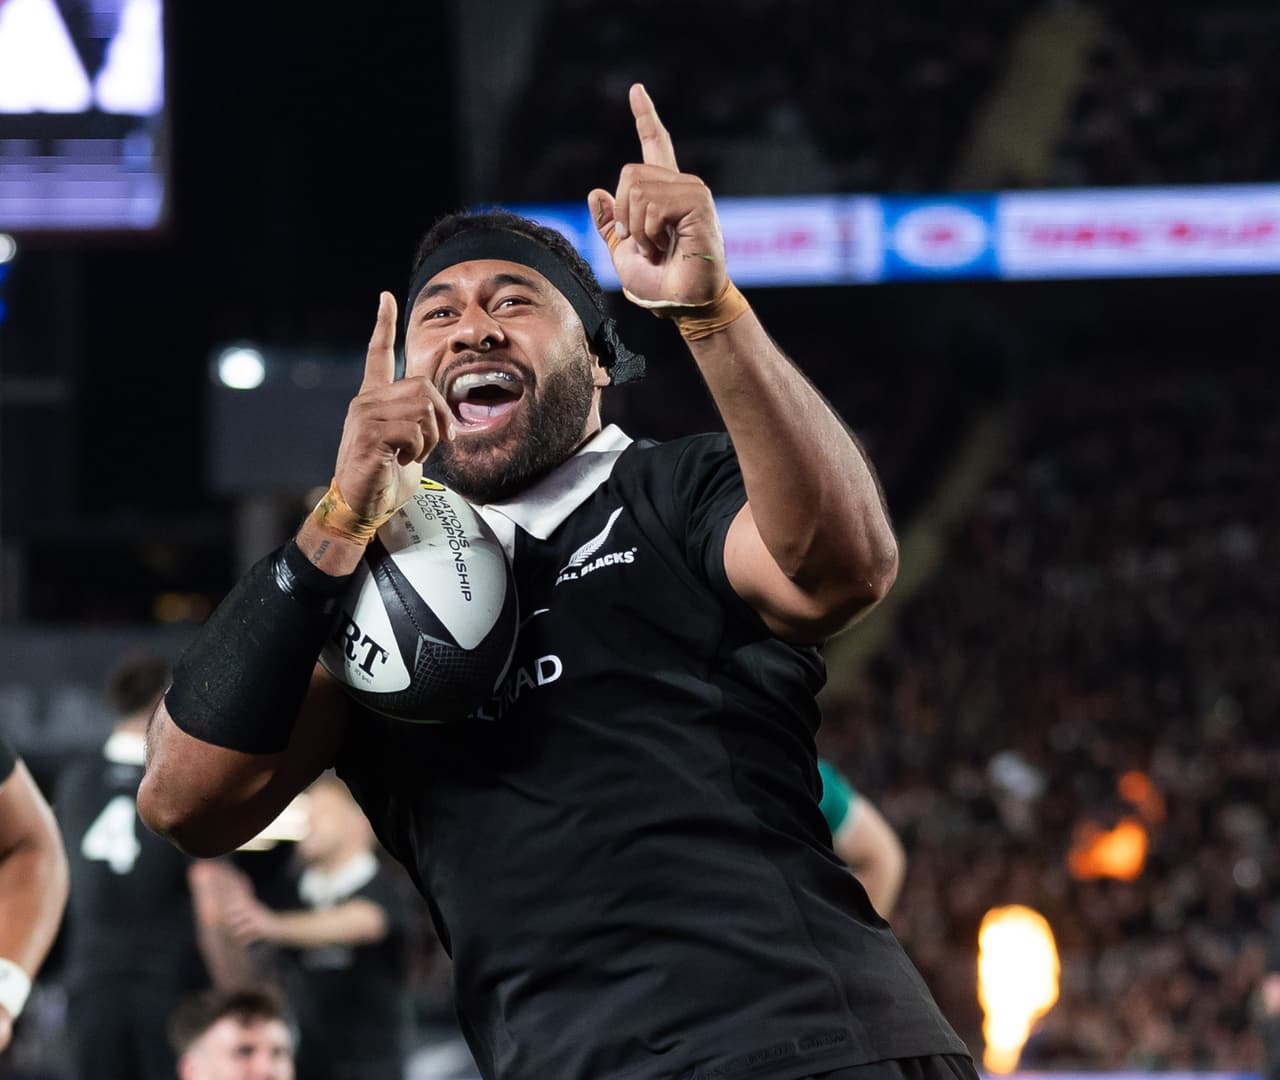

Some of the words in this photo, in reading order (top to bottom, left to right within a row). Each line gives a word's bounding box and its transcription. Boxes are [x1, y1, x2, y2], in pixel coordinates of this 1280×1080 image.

[413, 494, 436, 521] 2026
[434, 494, 470, 548] NATIONS
[424, 493, 472, 602] CHAMPIONSHIP
[581, 551, 635, 577] BLACKS
[343, 616, 390, 678] RT
[81, 795, 141, 875] 4
